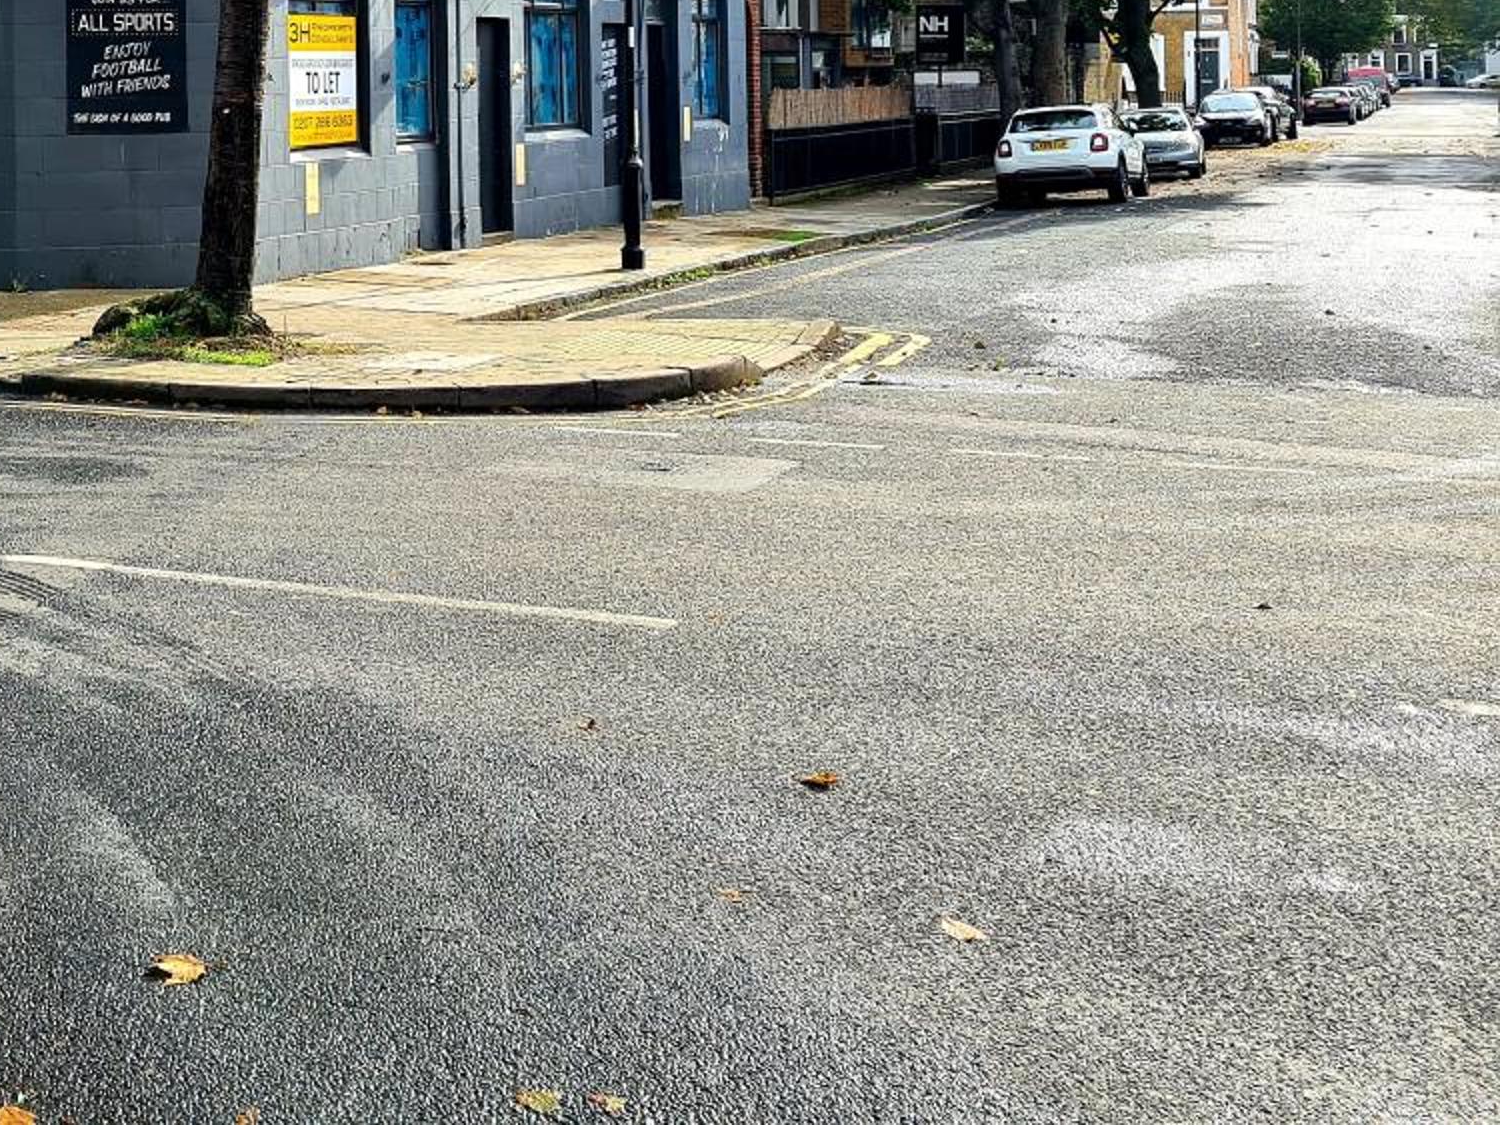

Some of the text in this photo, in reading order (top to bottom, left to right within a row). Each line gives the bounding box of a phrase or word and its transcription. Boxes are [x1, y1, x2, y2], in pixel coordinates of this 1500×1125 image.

[77, 12, 175, 32] ALL SPORTS
[289, 22, 311, 43] 3H
[920, 16, 948, 32] NH
[103, 41, 151, 60] ENJOY
[91, 58, 162, 79] FOOTBALL
[81, 75, 171, 98] WITH FRIENDS
[306, 71, 340, 94] TO LET
